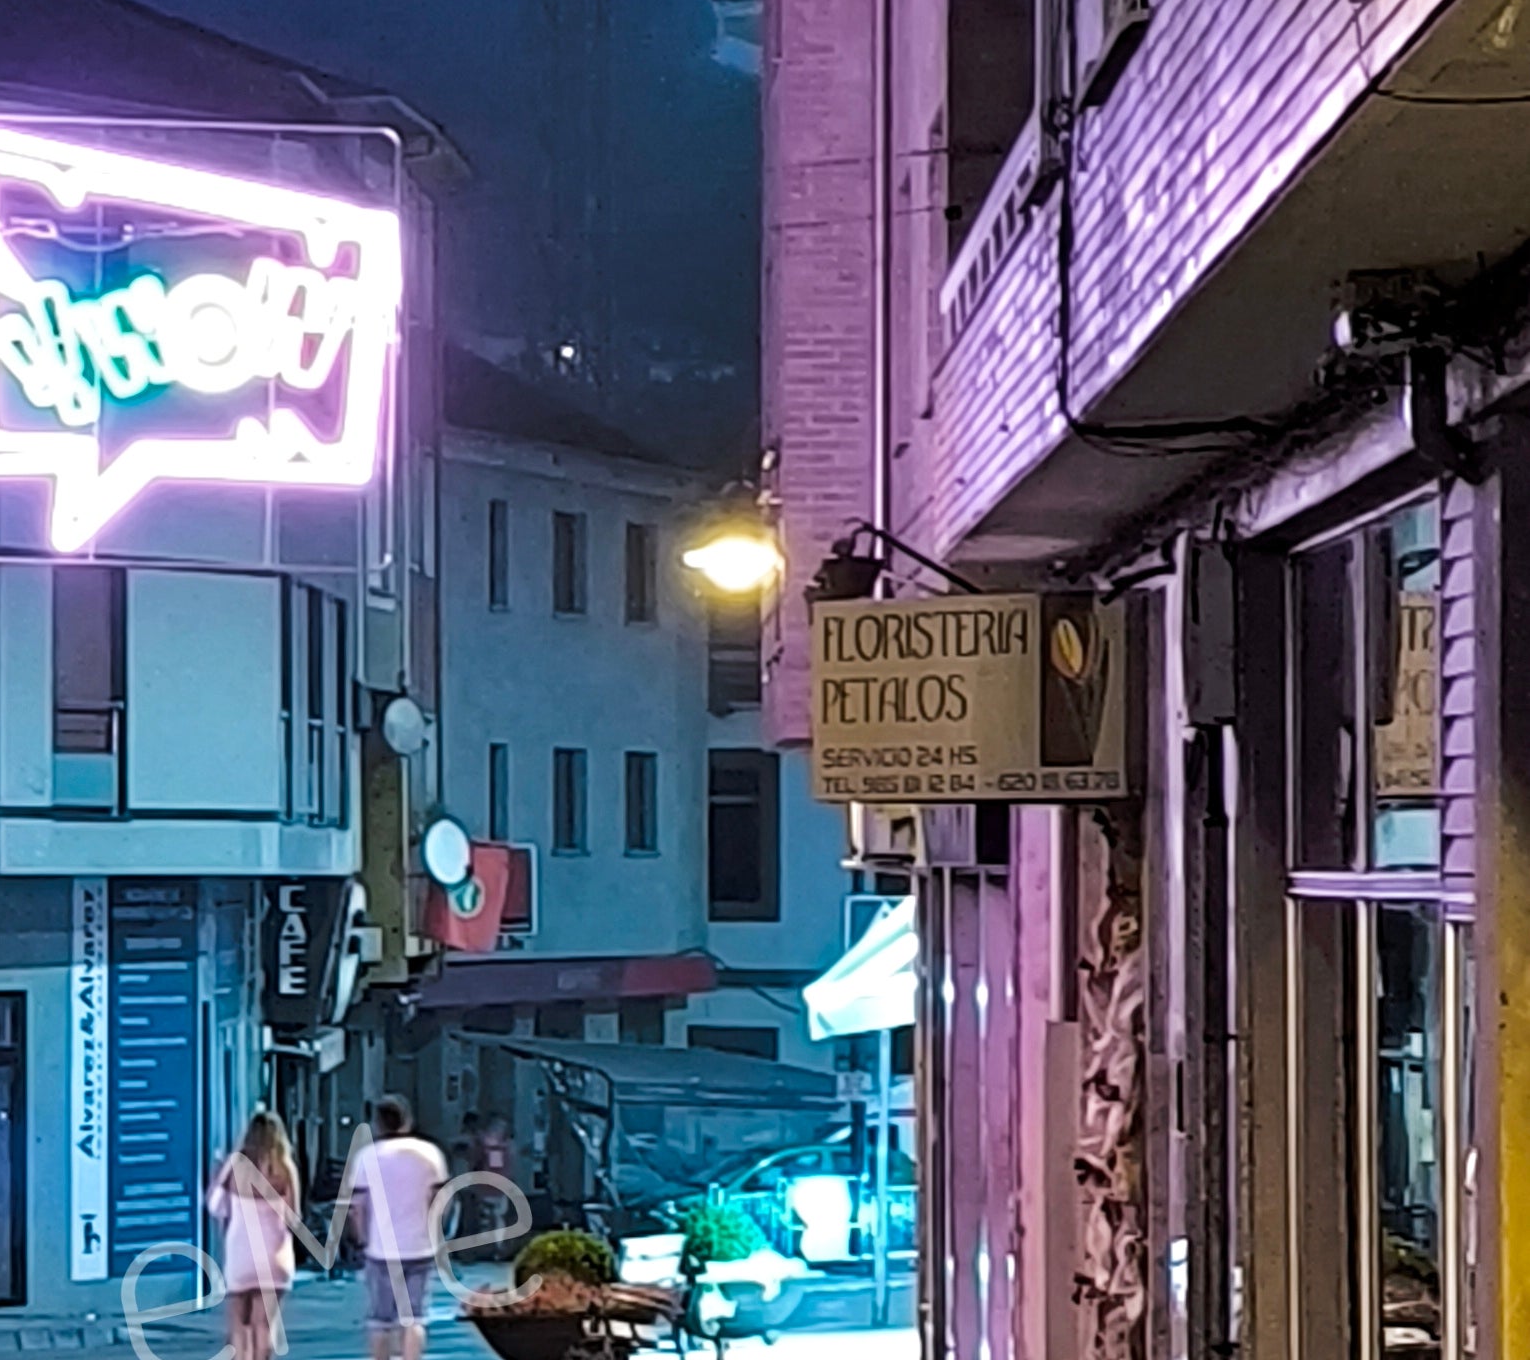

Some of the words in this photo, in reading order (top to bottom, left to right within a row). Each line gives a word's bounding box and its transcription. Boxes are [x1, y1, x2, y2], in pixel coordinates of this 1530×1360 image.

[823, 608, 1028, 662] FLORISTERIA
[822, 674, 968, 724] PETALOS
[822, 747, 912, 769] SERVICIO
[916, 745, 943, 767] 24
[278, 885, 307, 995] CAFE
